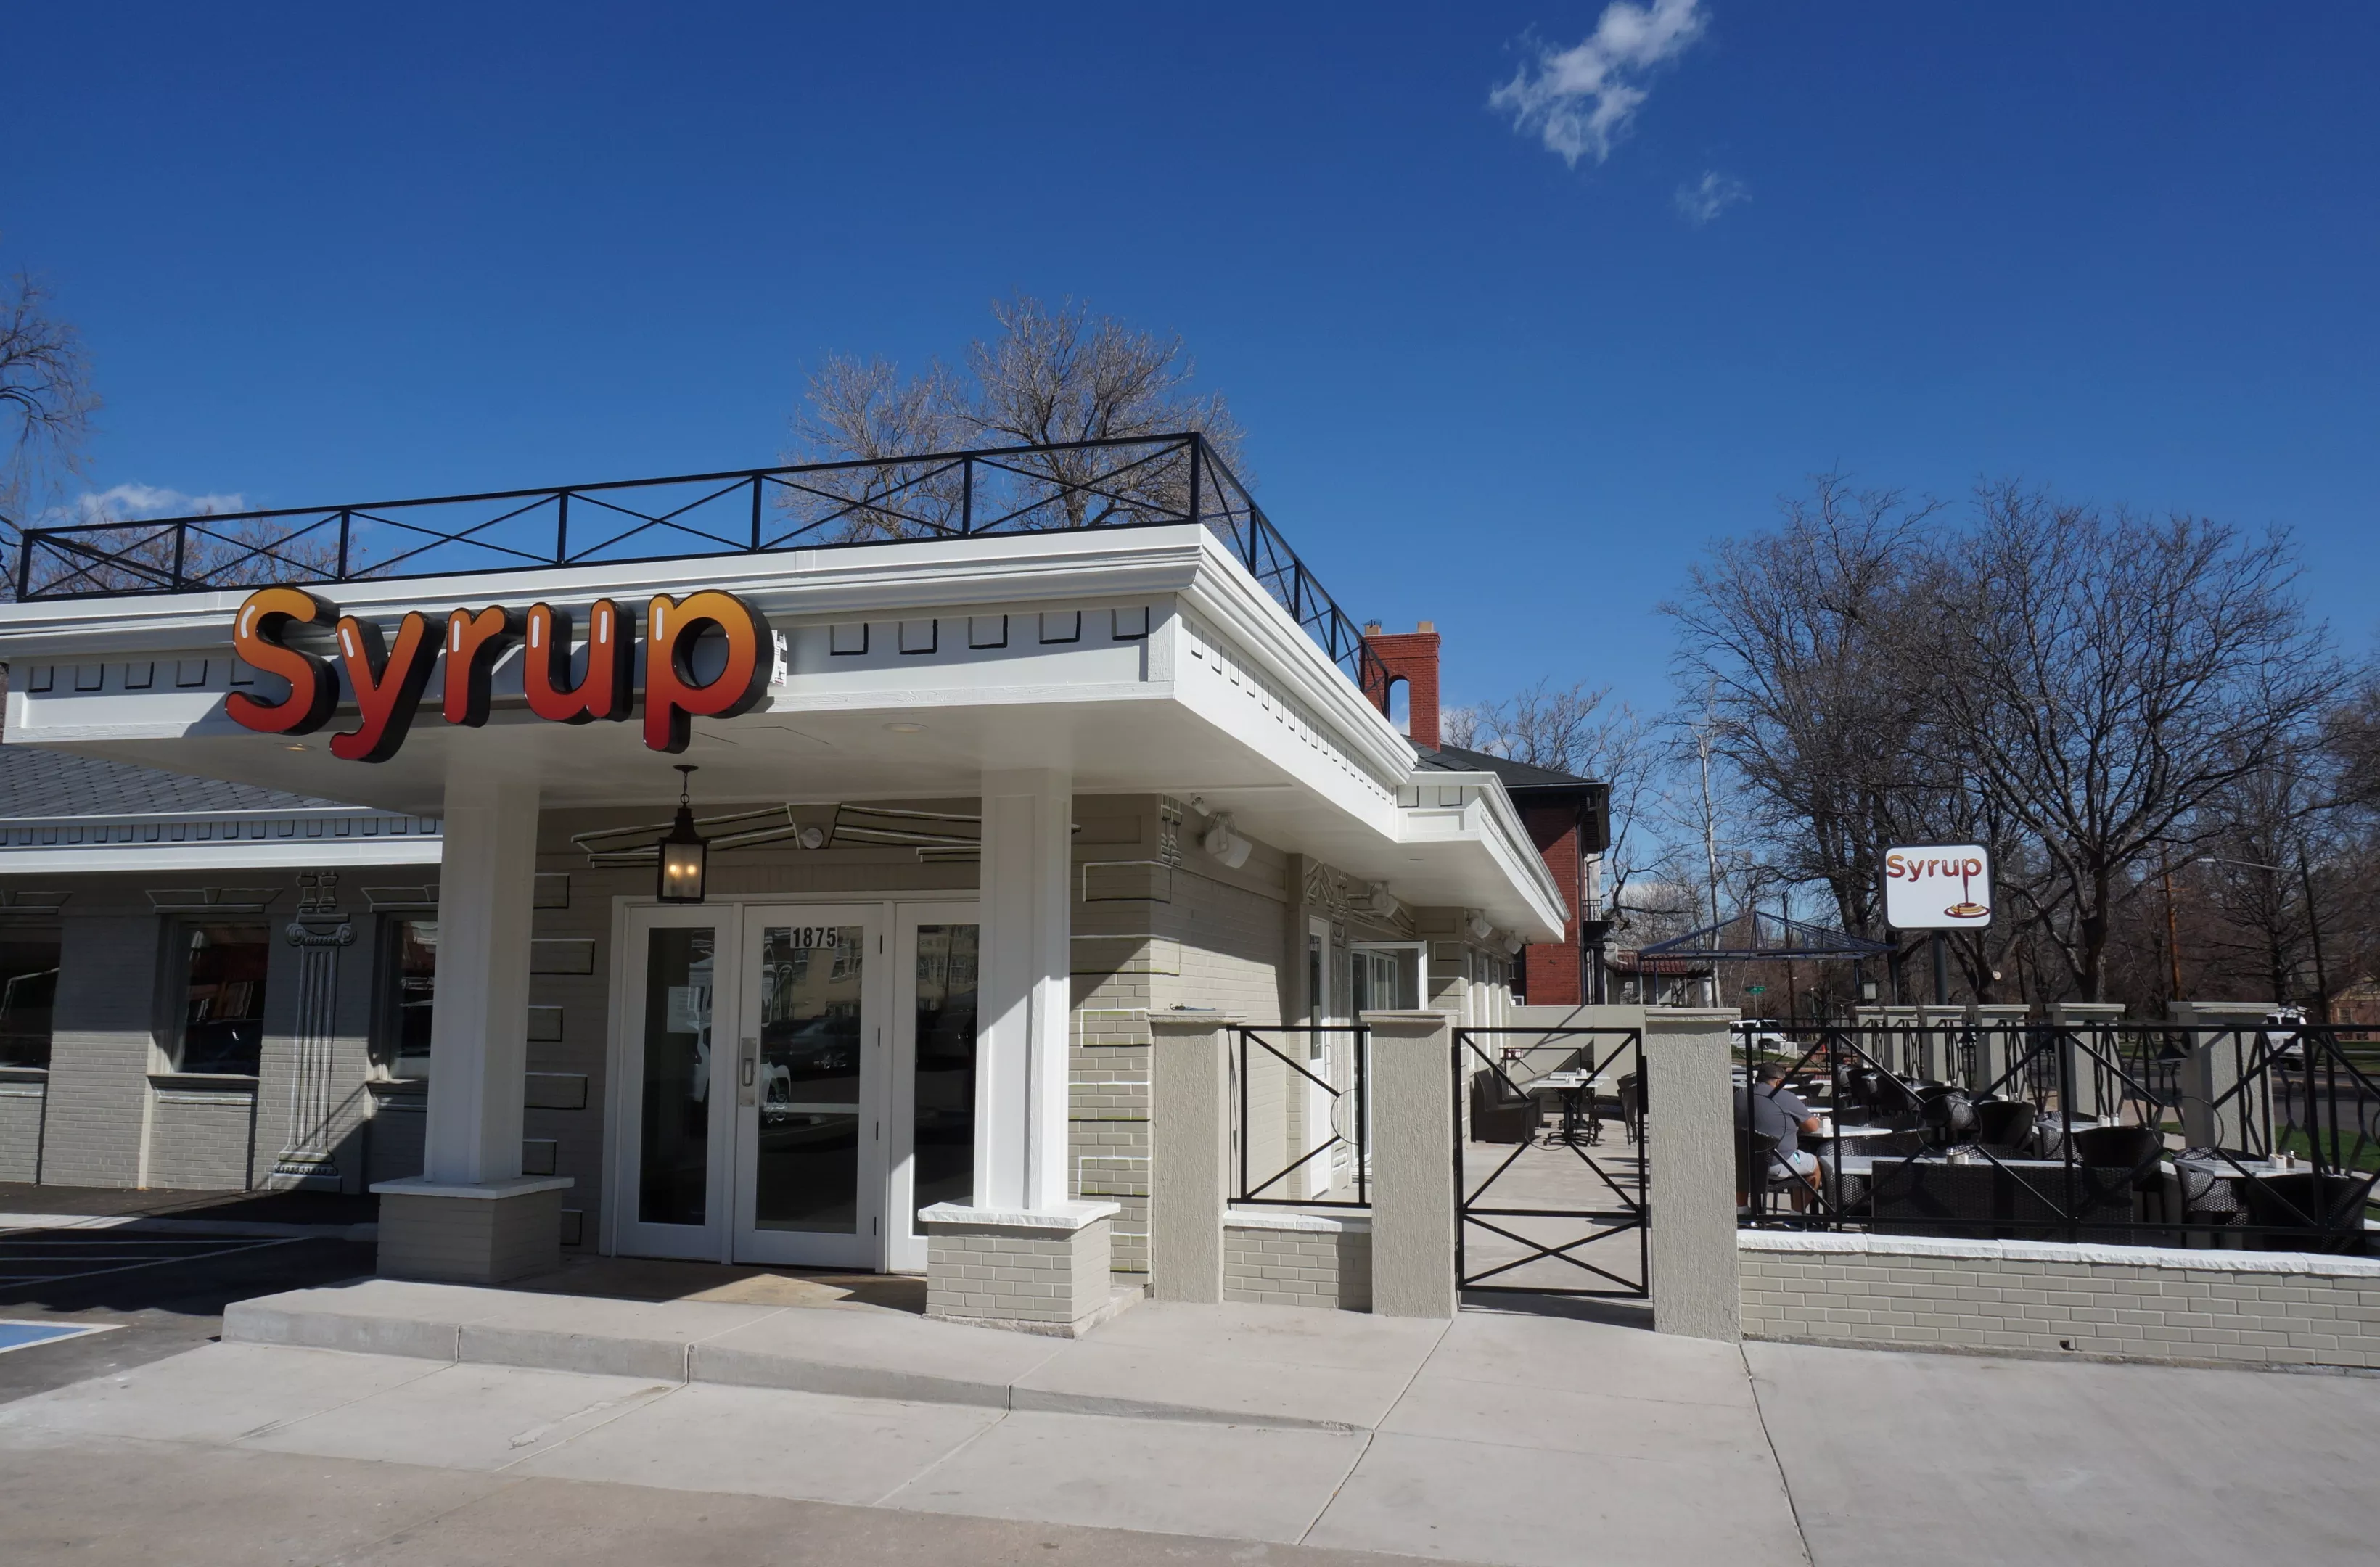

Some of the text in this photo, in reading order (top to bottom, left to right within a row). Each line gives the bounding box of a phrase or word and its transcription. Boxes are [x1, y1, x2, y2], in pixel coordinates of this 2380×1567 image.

[224, 588, 774, 764] Syrup
[1887, 855, 1982, 883] Syrup
[793, 927, 836, 947] 1875
